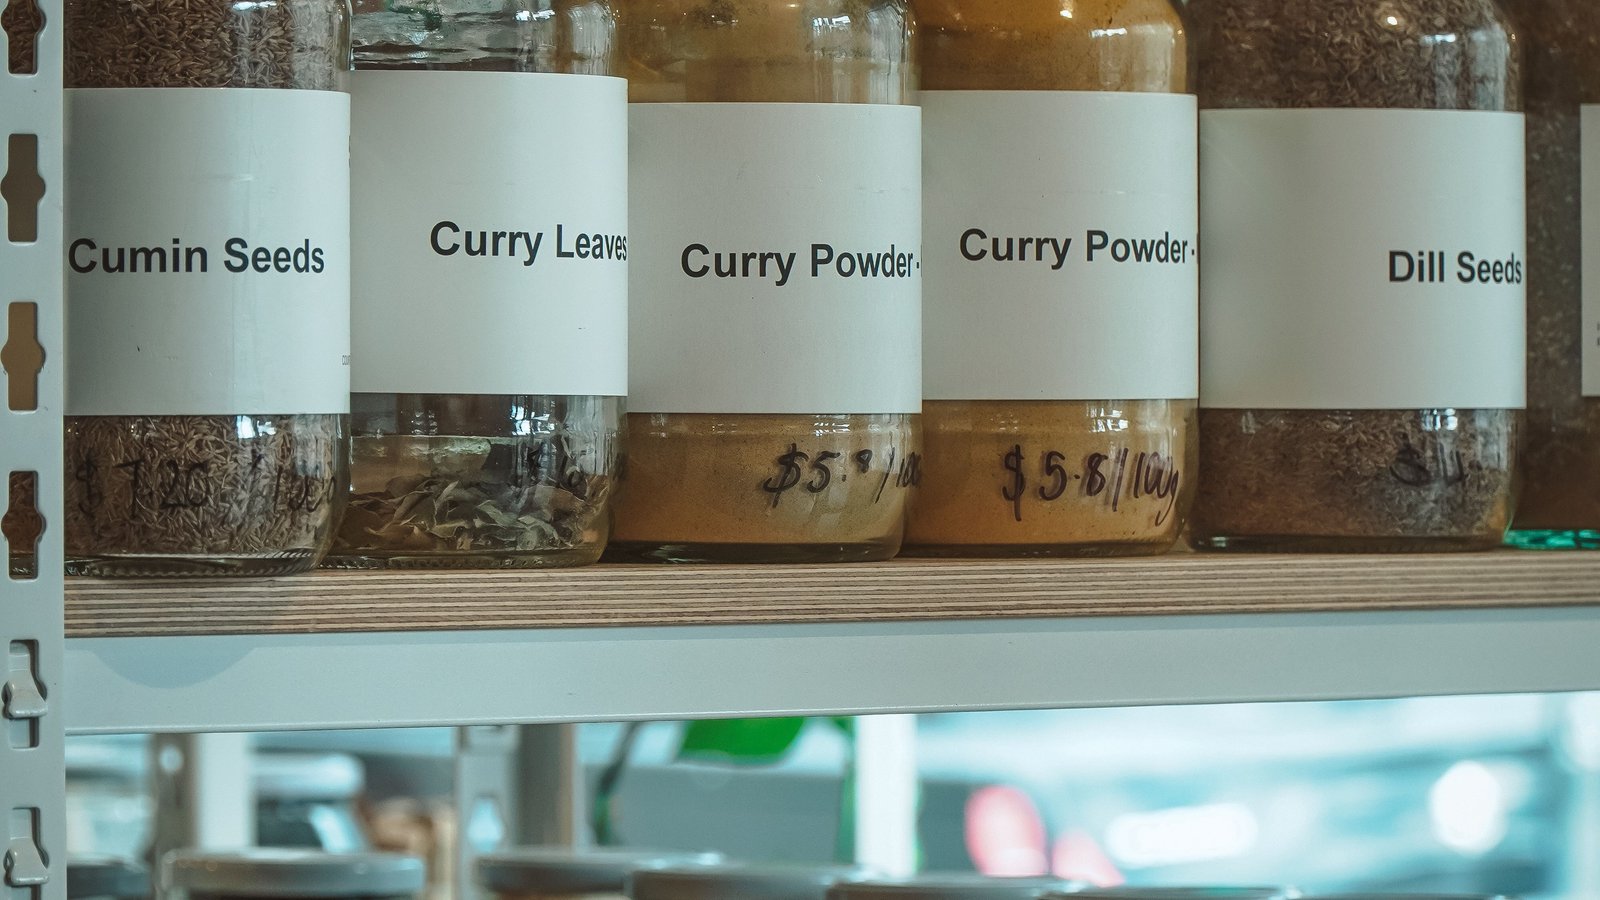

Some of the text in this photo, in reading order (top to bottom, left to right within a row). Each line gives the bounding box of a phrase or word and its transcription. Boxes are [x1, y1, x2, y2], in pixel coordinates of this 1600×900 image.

[69, 236, 325, 274] Cumin Seeds
[430, 220, 627, 266] Curry Leaves
[681, 243, 796, 286] Curry
[960, 227, 1072, 270] Curry
[1388, 251, 1522, 285] Dill Seeds
